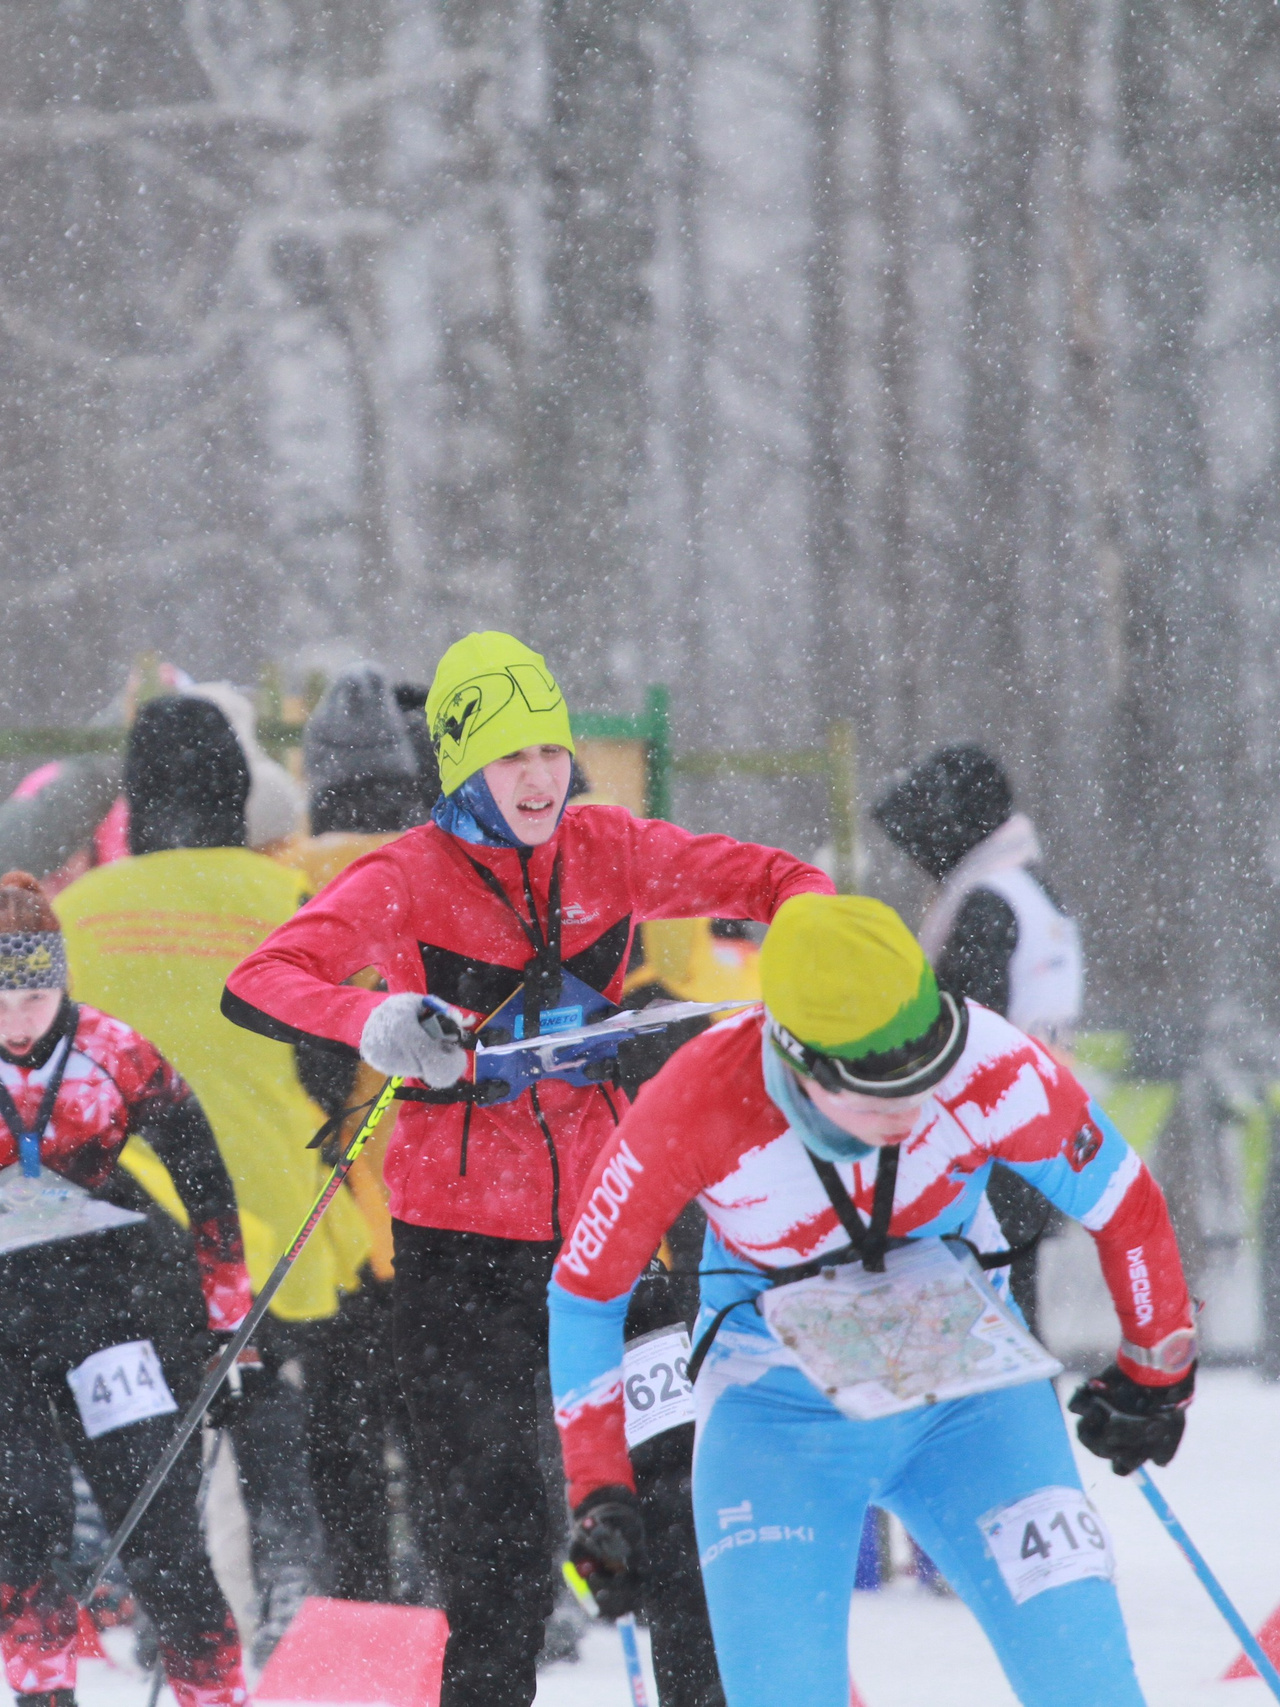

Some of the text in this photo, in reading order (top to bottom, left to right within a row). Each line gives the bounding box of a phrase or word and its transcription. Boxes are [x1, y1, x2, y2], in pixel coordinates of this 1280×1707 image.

[539, 1014, 578, 1027] GNETO
[560, 1137, 645, 1277] МОСКВА
[91, 1360, 154, 1404] 414
[624, 1356, 693, 1412] 629
[1021, 1511, 1106, 1560] 419
